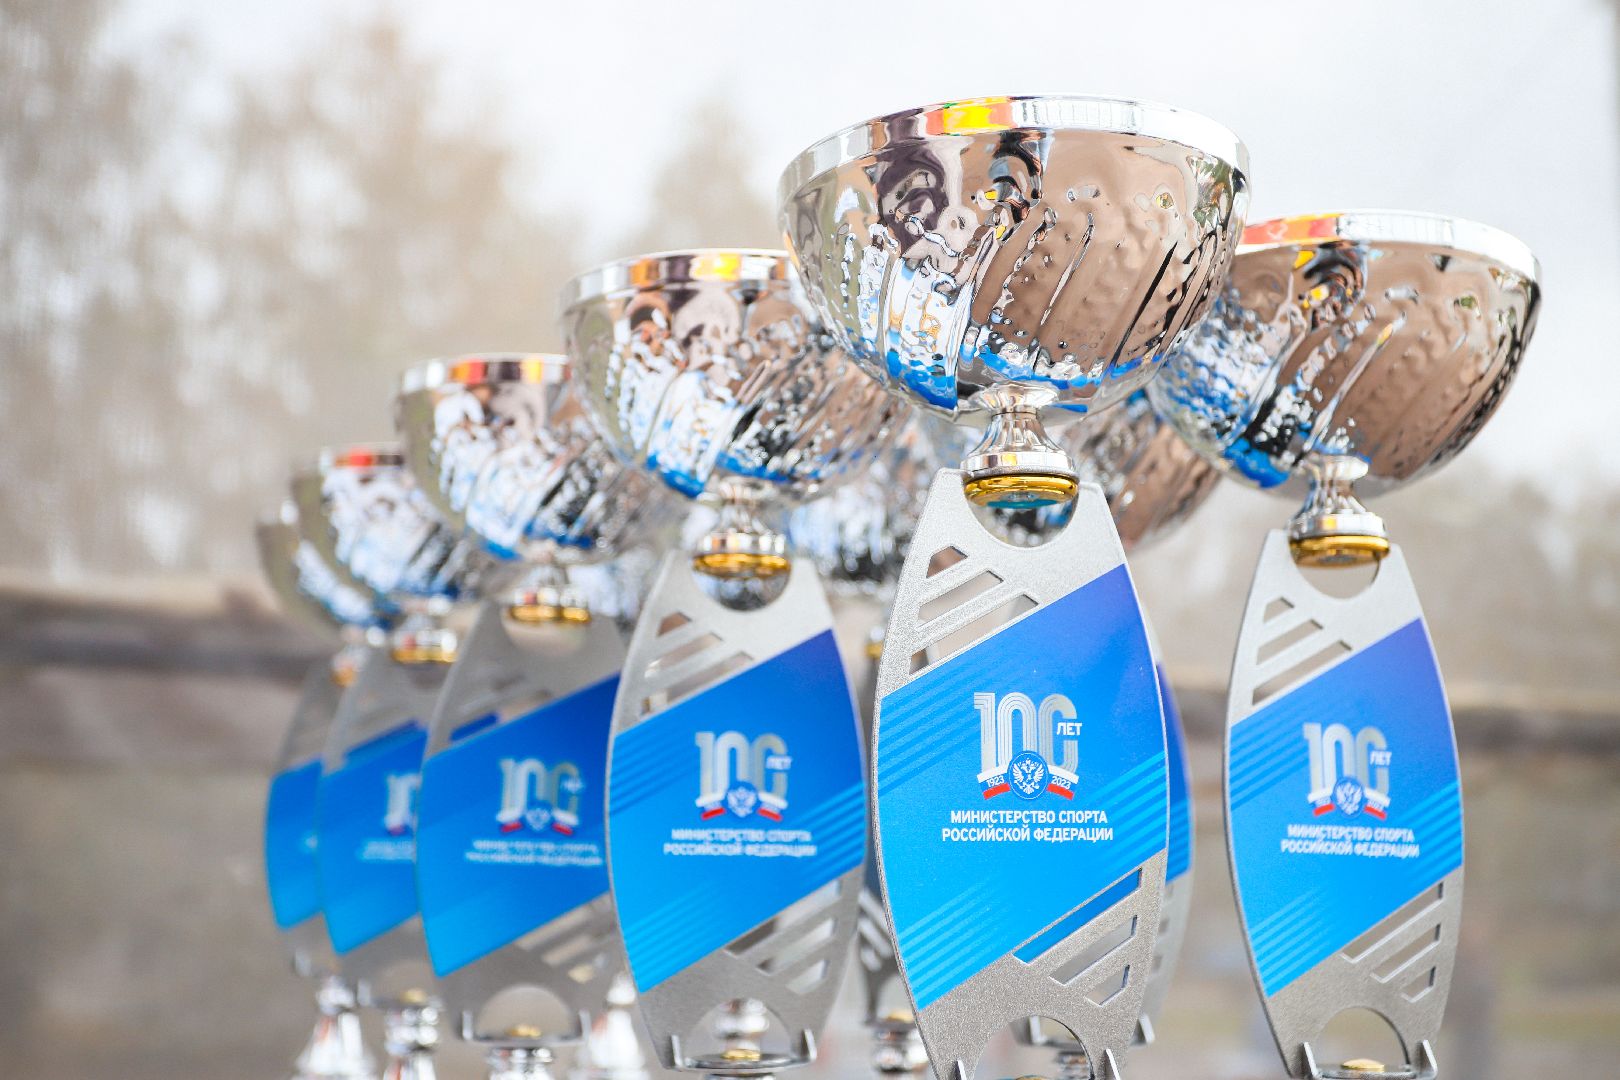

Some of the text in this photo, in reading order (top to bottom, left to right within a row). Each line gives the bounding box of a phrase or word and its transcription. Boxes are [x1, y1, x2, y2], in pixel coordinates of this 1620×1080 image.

[974, 692, 1079, 774] 100
[1056, 722, 1082, 736] ЛЕТ
[987, 775, 1005, 788] 1923
[1051, 775, 1072, 790] 2023
[950, 810, 1108, 824] МИНИСТЕРСТВО СПОРТА
[942, 825, 1114, 843] РОССИЙСКОЙ ФЕДЕРАЦИИ
